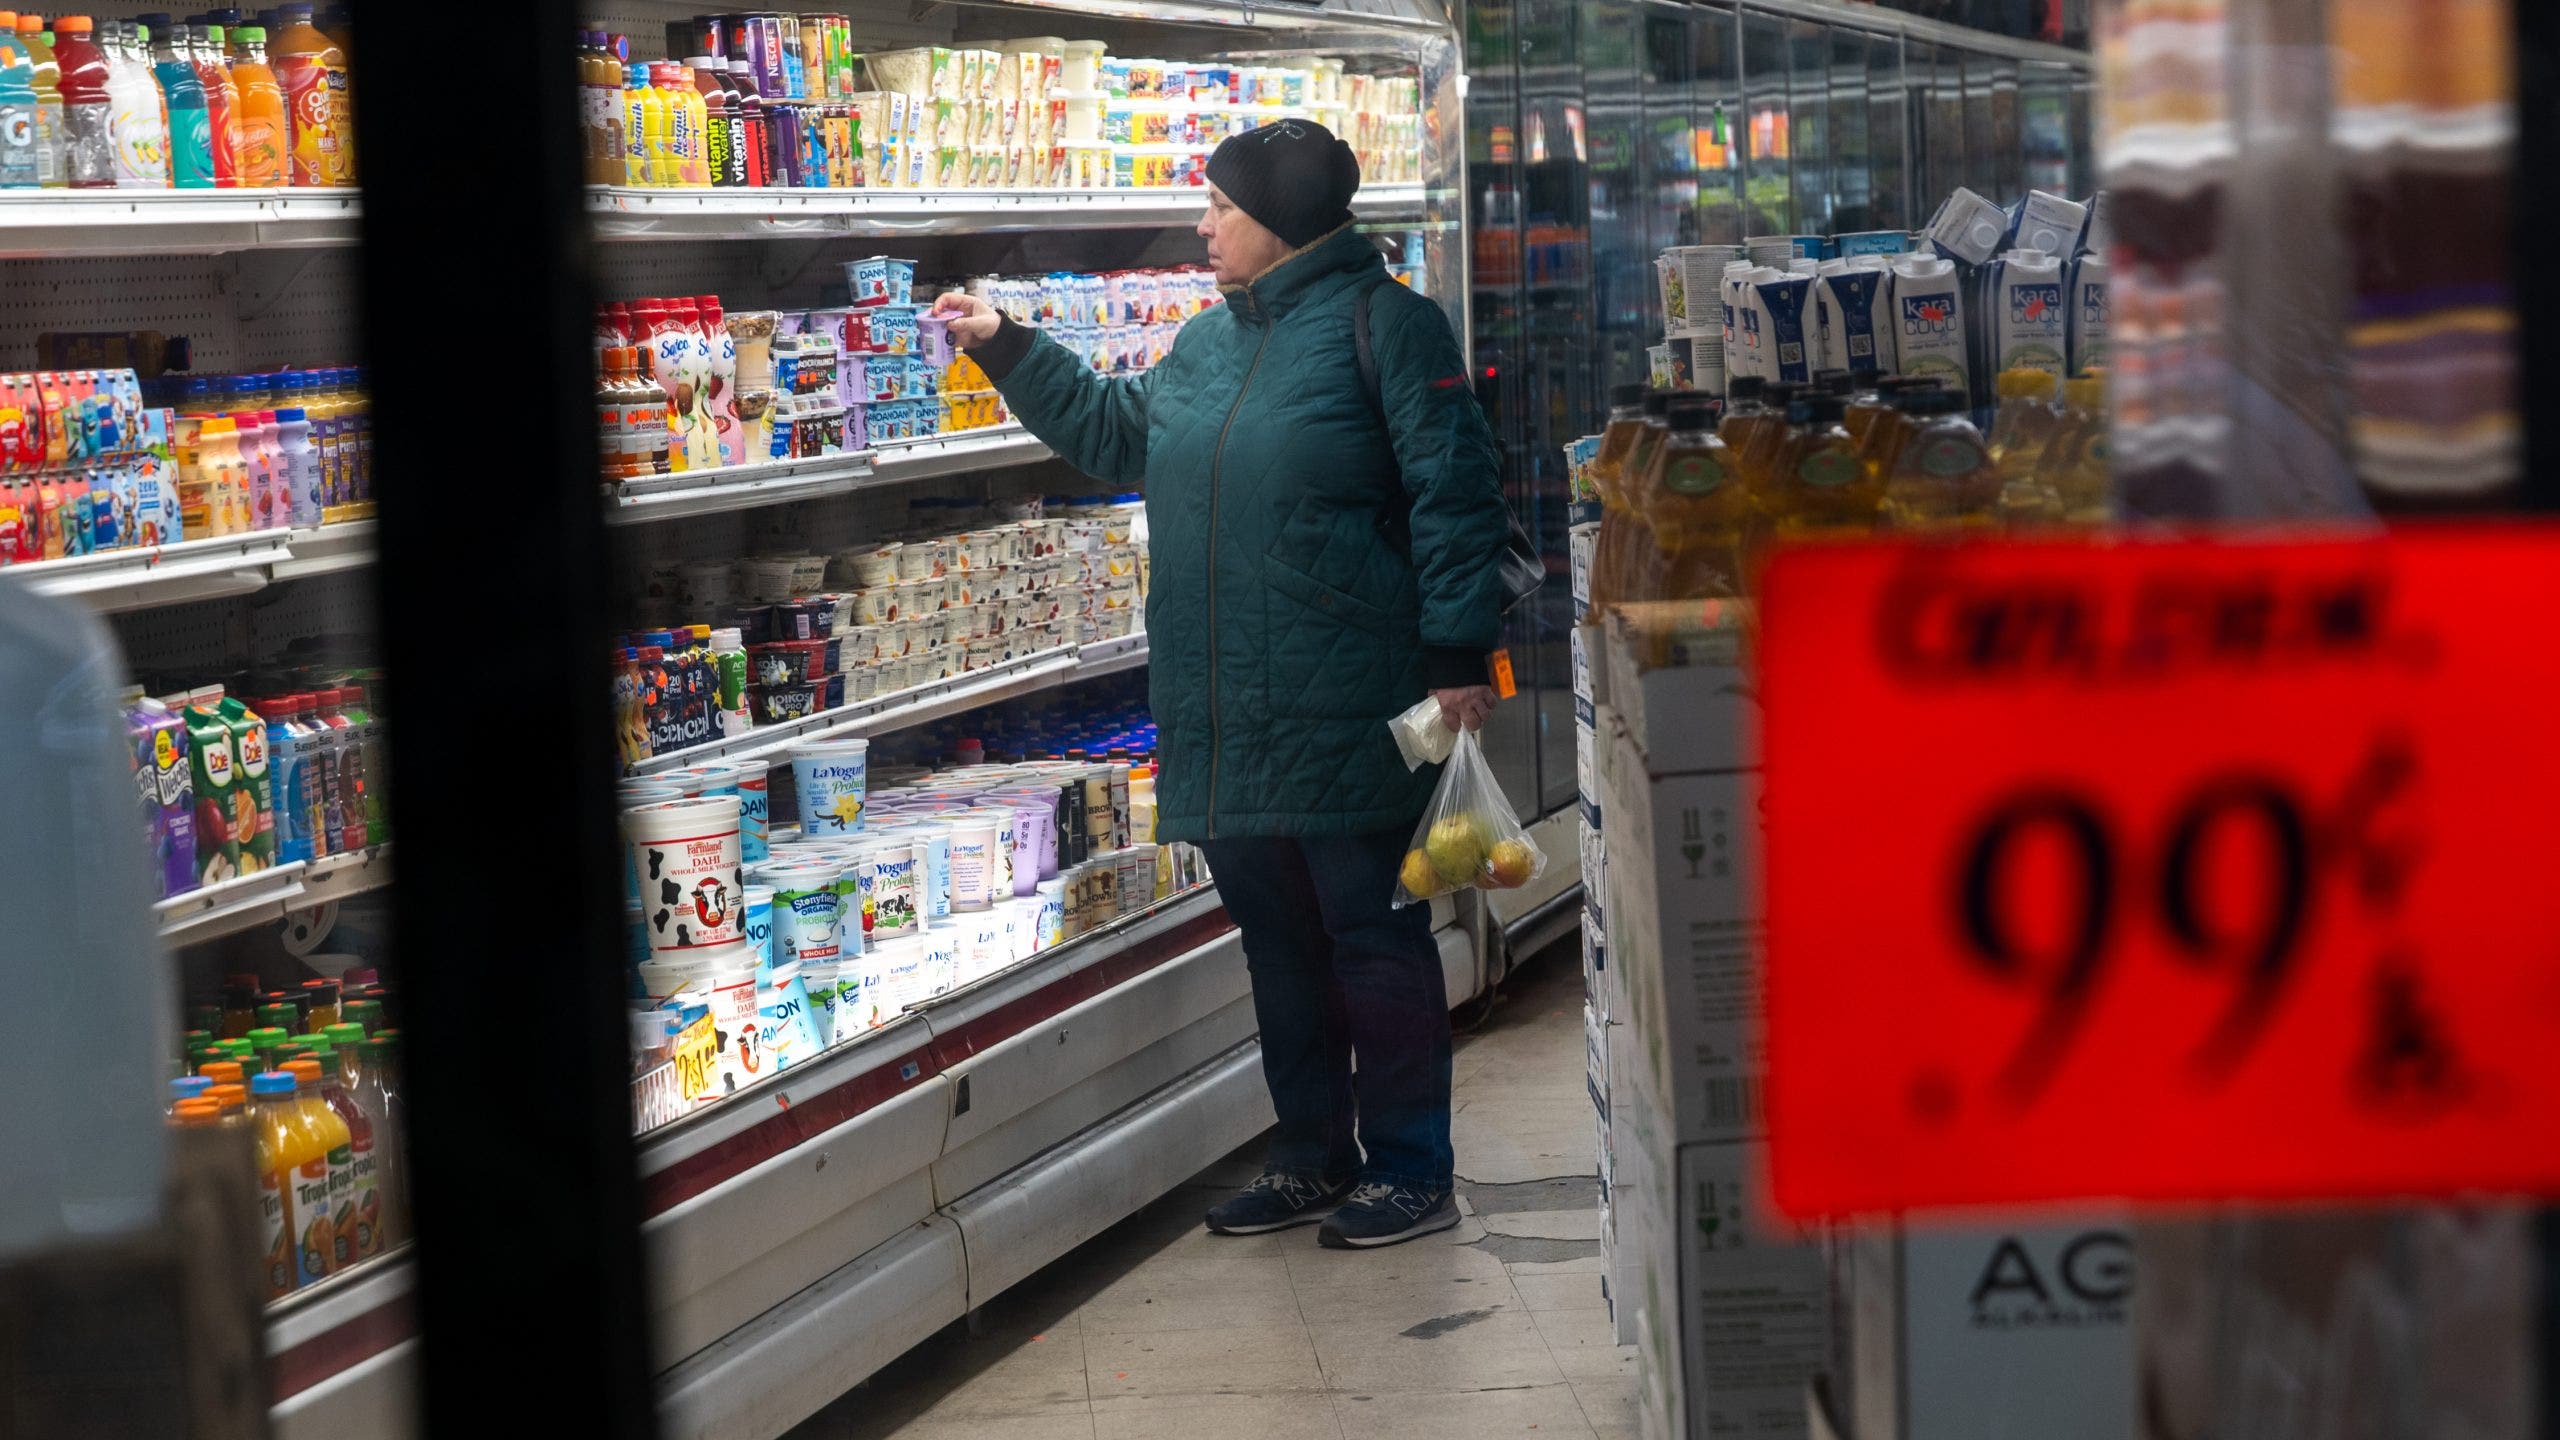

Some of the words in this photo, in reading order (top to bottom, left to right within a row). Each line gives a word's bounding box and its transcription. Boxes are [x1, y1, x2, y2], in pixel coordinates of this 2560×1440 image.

[4, 112, 31, 147] G
[707, 118, 723, 182] vitamin
[730, 118, 745, 182] vitamin
[210, 752, 228, 769] Dole
[812, 768, 828, 779] La
[693, 855, 720, 867] DAHI
[671, 866, 698, 876] WHOLE
[698, 864, 715, 873] MILK
[794, 891, 838, 911] Stonyfield
[801, 905, 834, 916] ORGANIC
